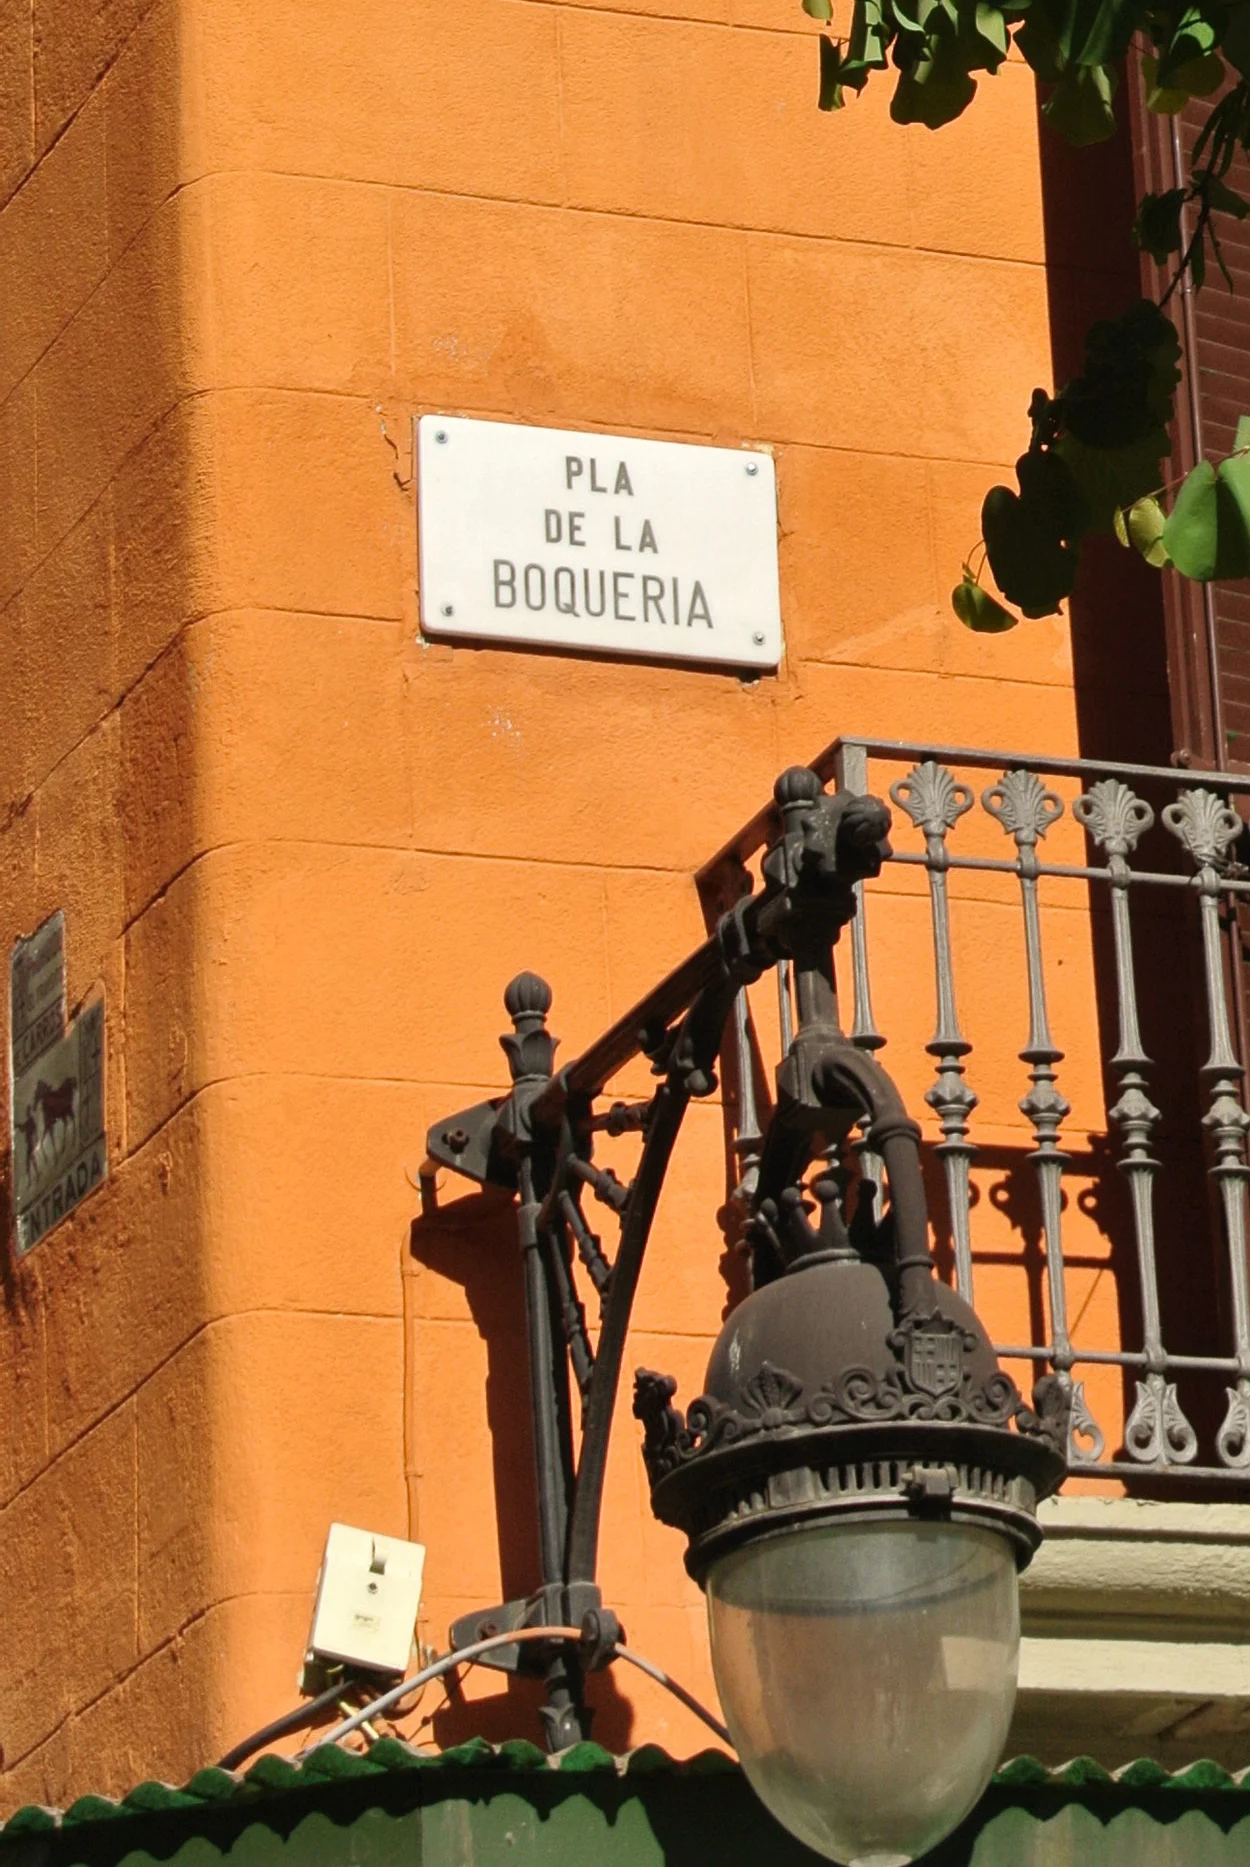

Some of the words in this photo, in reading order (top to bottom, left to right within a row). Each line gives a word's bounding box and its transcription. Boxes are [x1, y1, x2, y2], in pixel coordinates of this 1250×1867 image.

[565, 455, 634, 496] PLA
[544, 508, 586, 547] DE
[614, 515, 659, 554] LA
[493, 558, 714, 629] BOQUERIA
